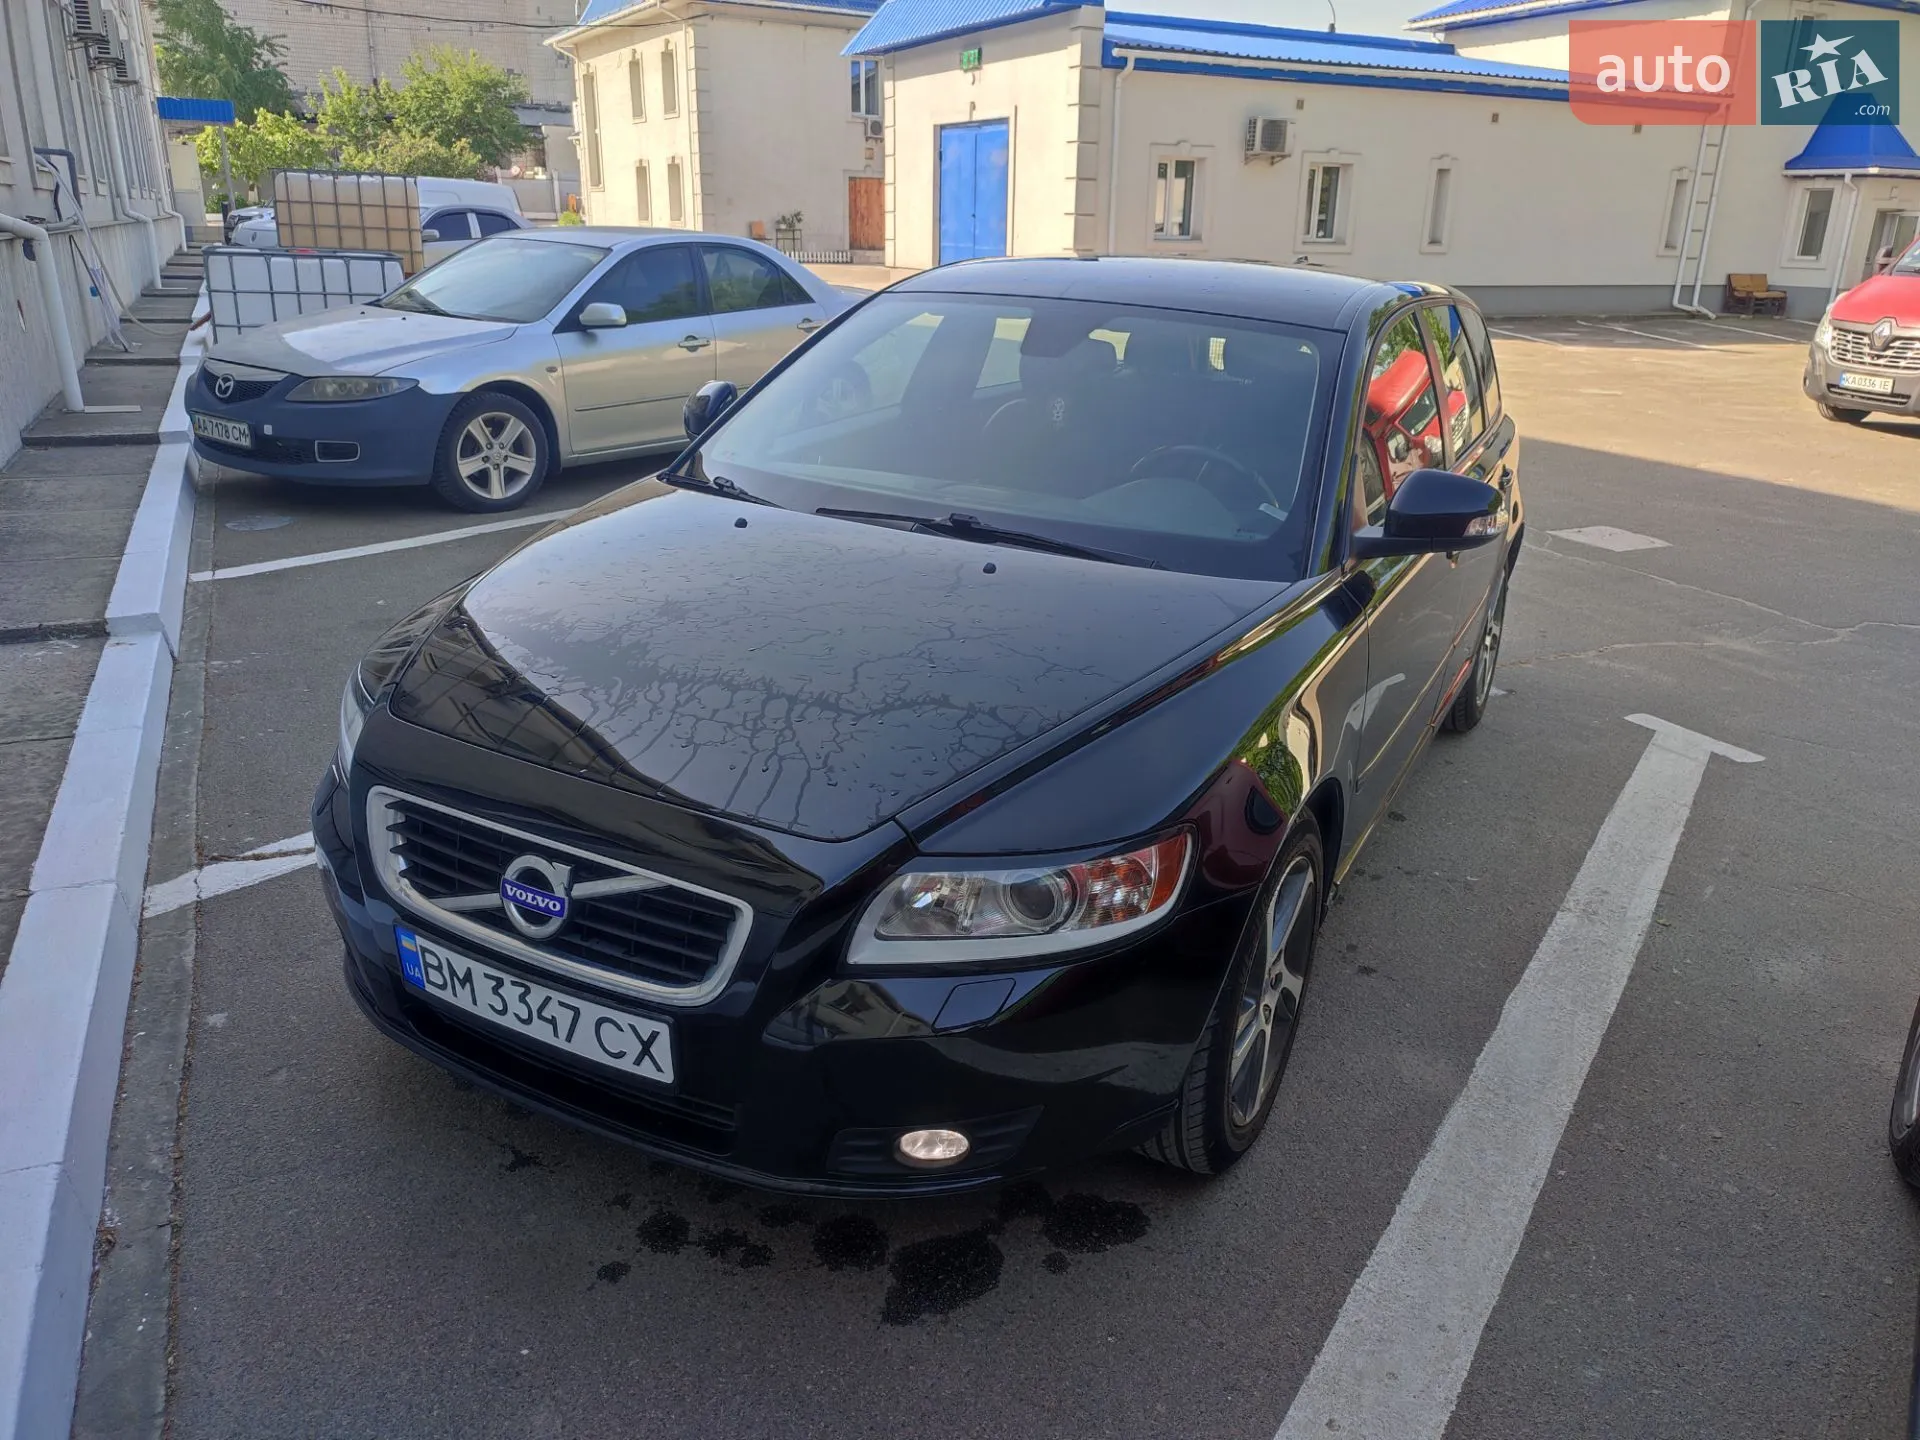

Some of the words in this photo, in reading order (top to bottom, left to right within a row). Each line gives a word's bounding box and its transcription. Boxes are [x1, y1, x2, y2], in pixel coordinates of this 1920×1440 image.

[231, 425, 247, 443] CM
[504, 882, 562, 913] VOLVO
[405, 961, 423, 981] UA
[419, 946, 478, 1007] BM
[483, 971, 581, 1044] 3347
[594, 1016, 665, 1074] CX
